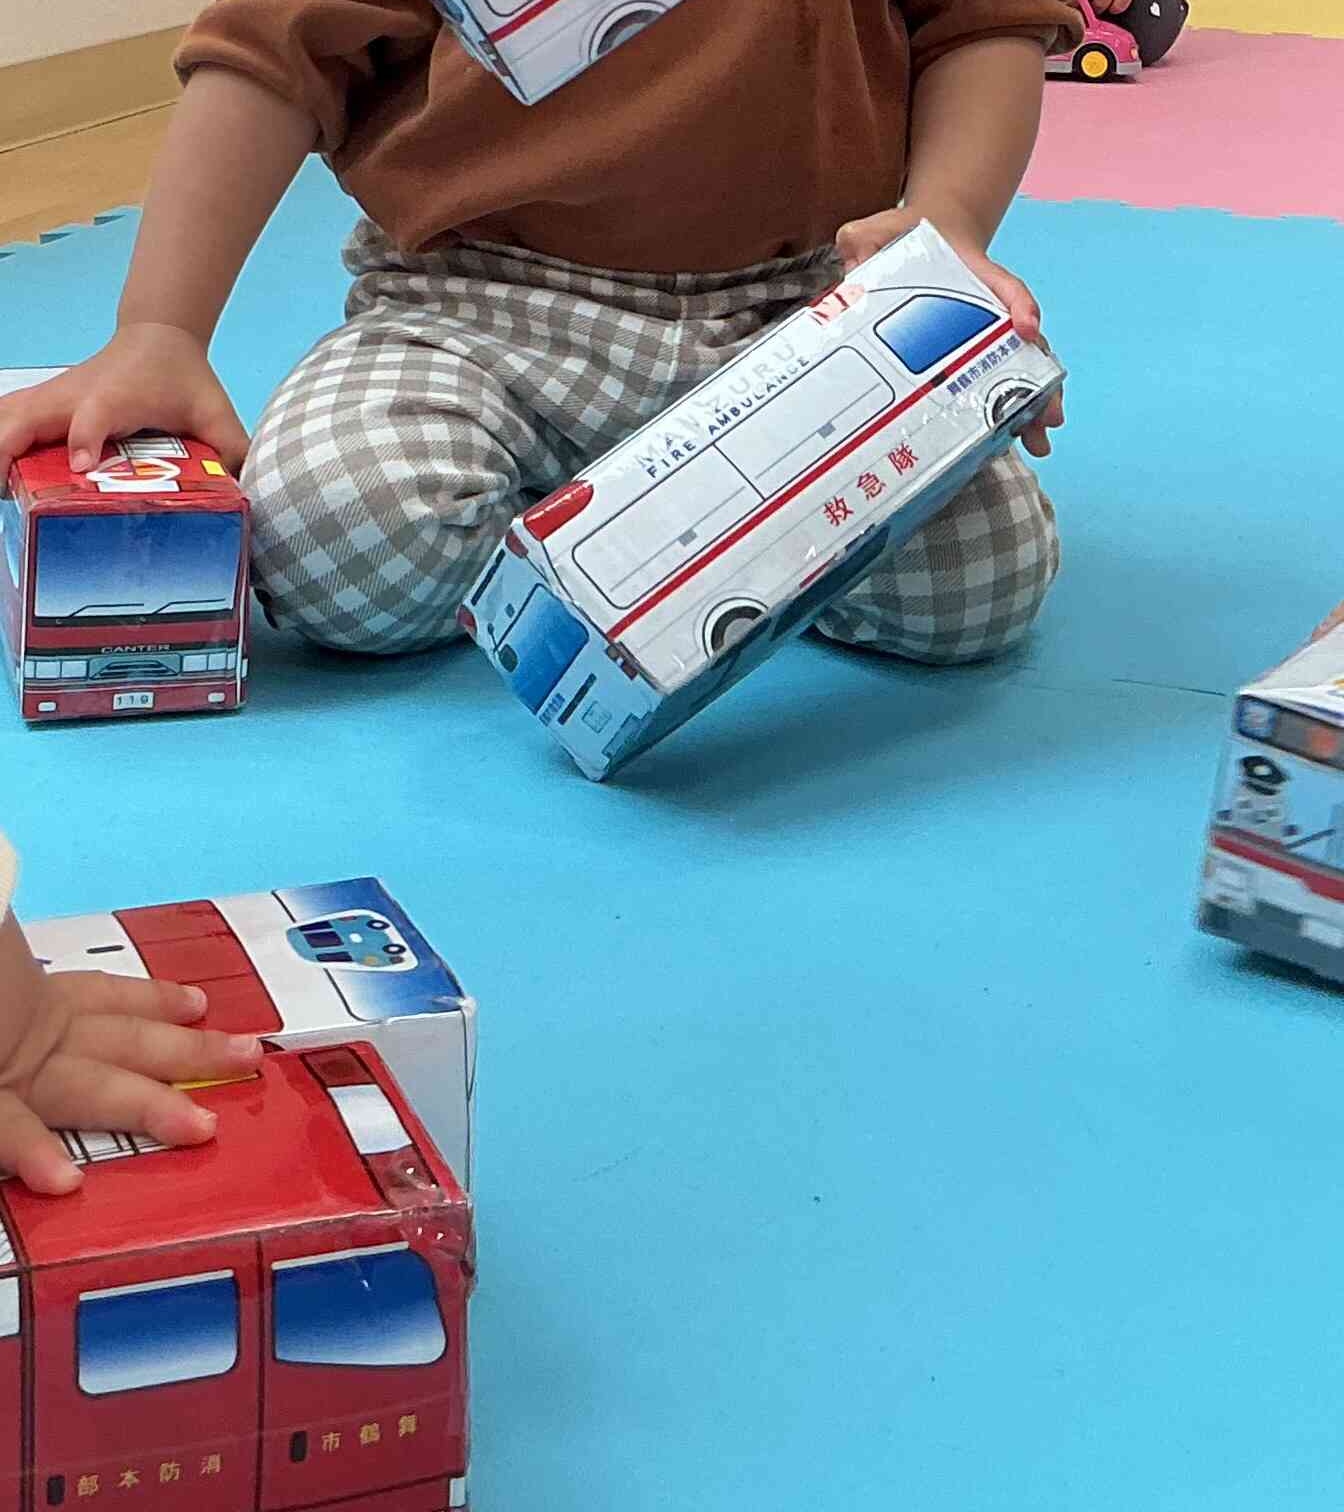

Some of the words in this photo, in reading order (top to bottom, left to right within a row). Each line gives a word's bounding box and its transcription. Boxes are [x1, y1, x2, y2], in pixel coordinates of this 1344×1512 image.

[646, 440, 696, 478] FIRE
[708, 355, 811, 438] AMBULANCE
[824, 440, 919, 527] 救急隊
